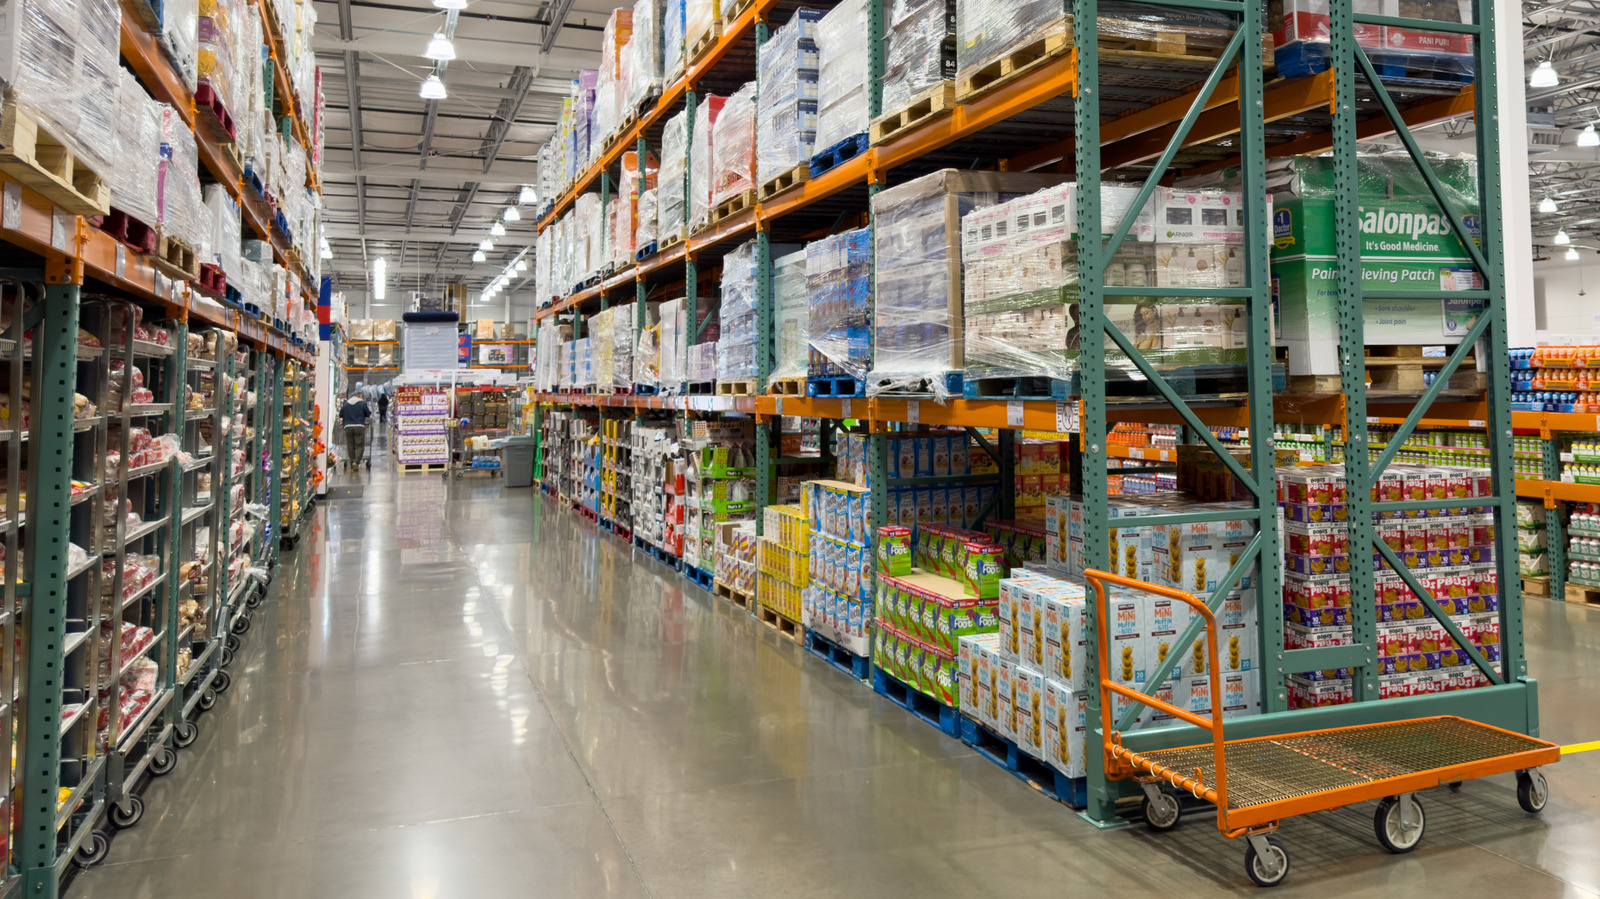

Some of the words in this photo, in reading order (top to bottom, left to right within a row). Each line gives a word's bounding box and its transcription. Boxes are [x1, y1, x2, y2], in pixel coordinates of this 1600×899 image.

[1435, 38, 1449, 46] PURI
[1366, 241, 1379, 250] It's
[1380, 242, 1401, 250] Good
[1402, 242, 1440, 252] Medicine.
[1362, 268, 1398, 283] ieving
[1401, 269, 1435, 281] Patch
